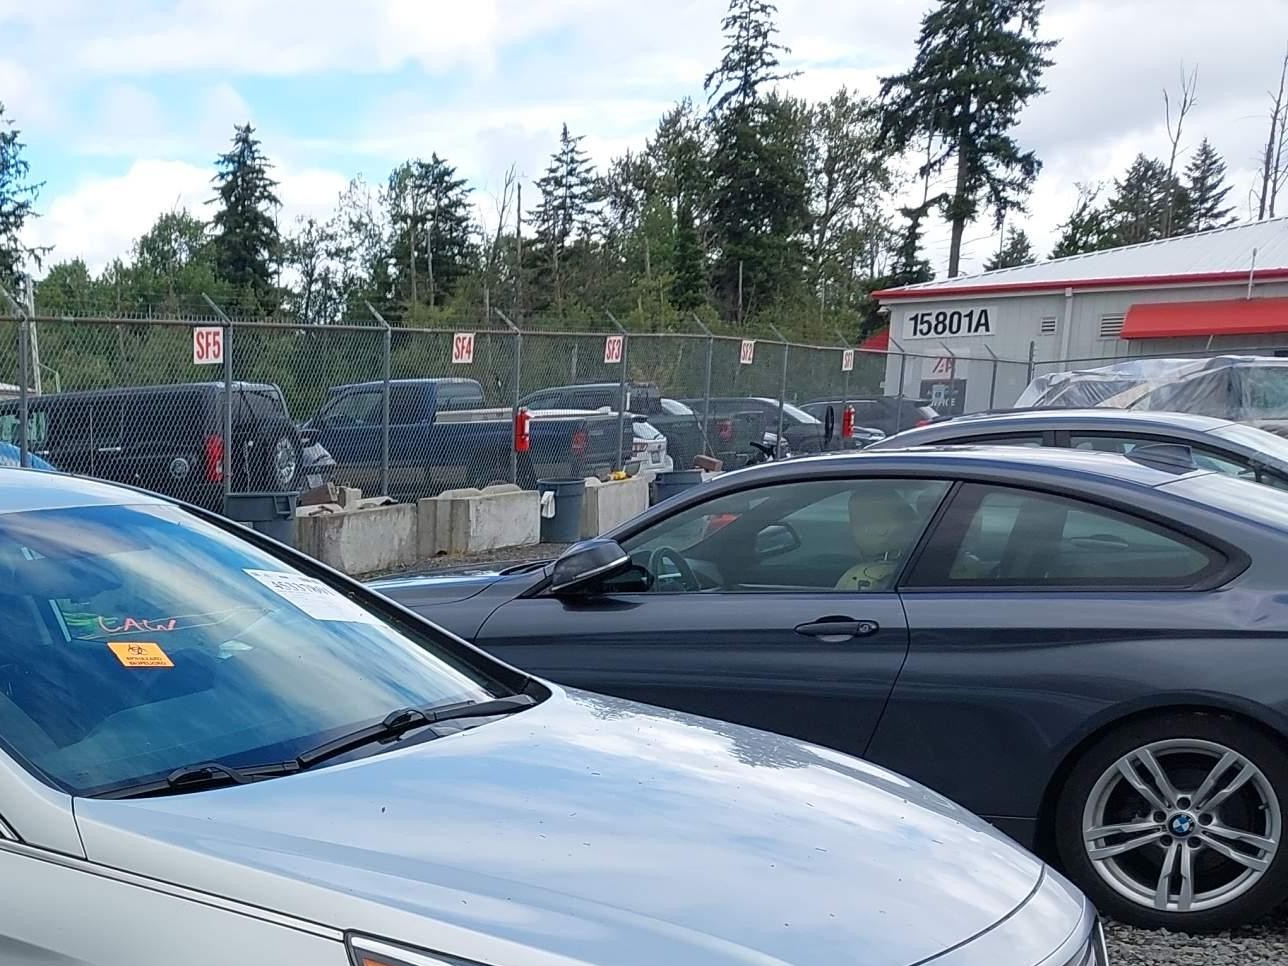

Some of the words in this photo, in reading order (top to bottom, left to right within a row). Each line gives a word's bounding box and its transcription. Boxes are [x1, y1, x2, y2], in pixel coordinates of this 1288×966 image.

[909, 309, 991, 336] 15801A
[196, 331, 221, 360] SF5
[454, 336, 472, 360] SF4
[607, 339, 621, 360] SF3
[98, 616, 177, 634] LAW
